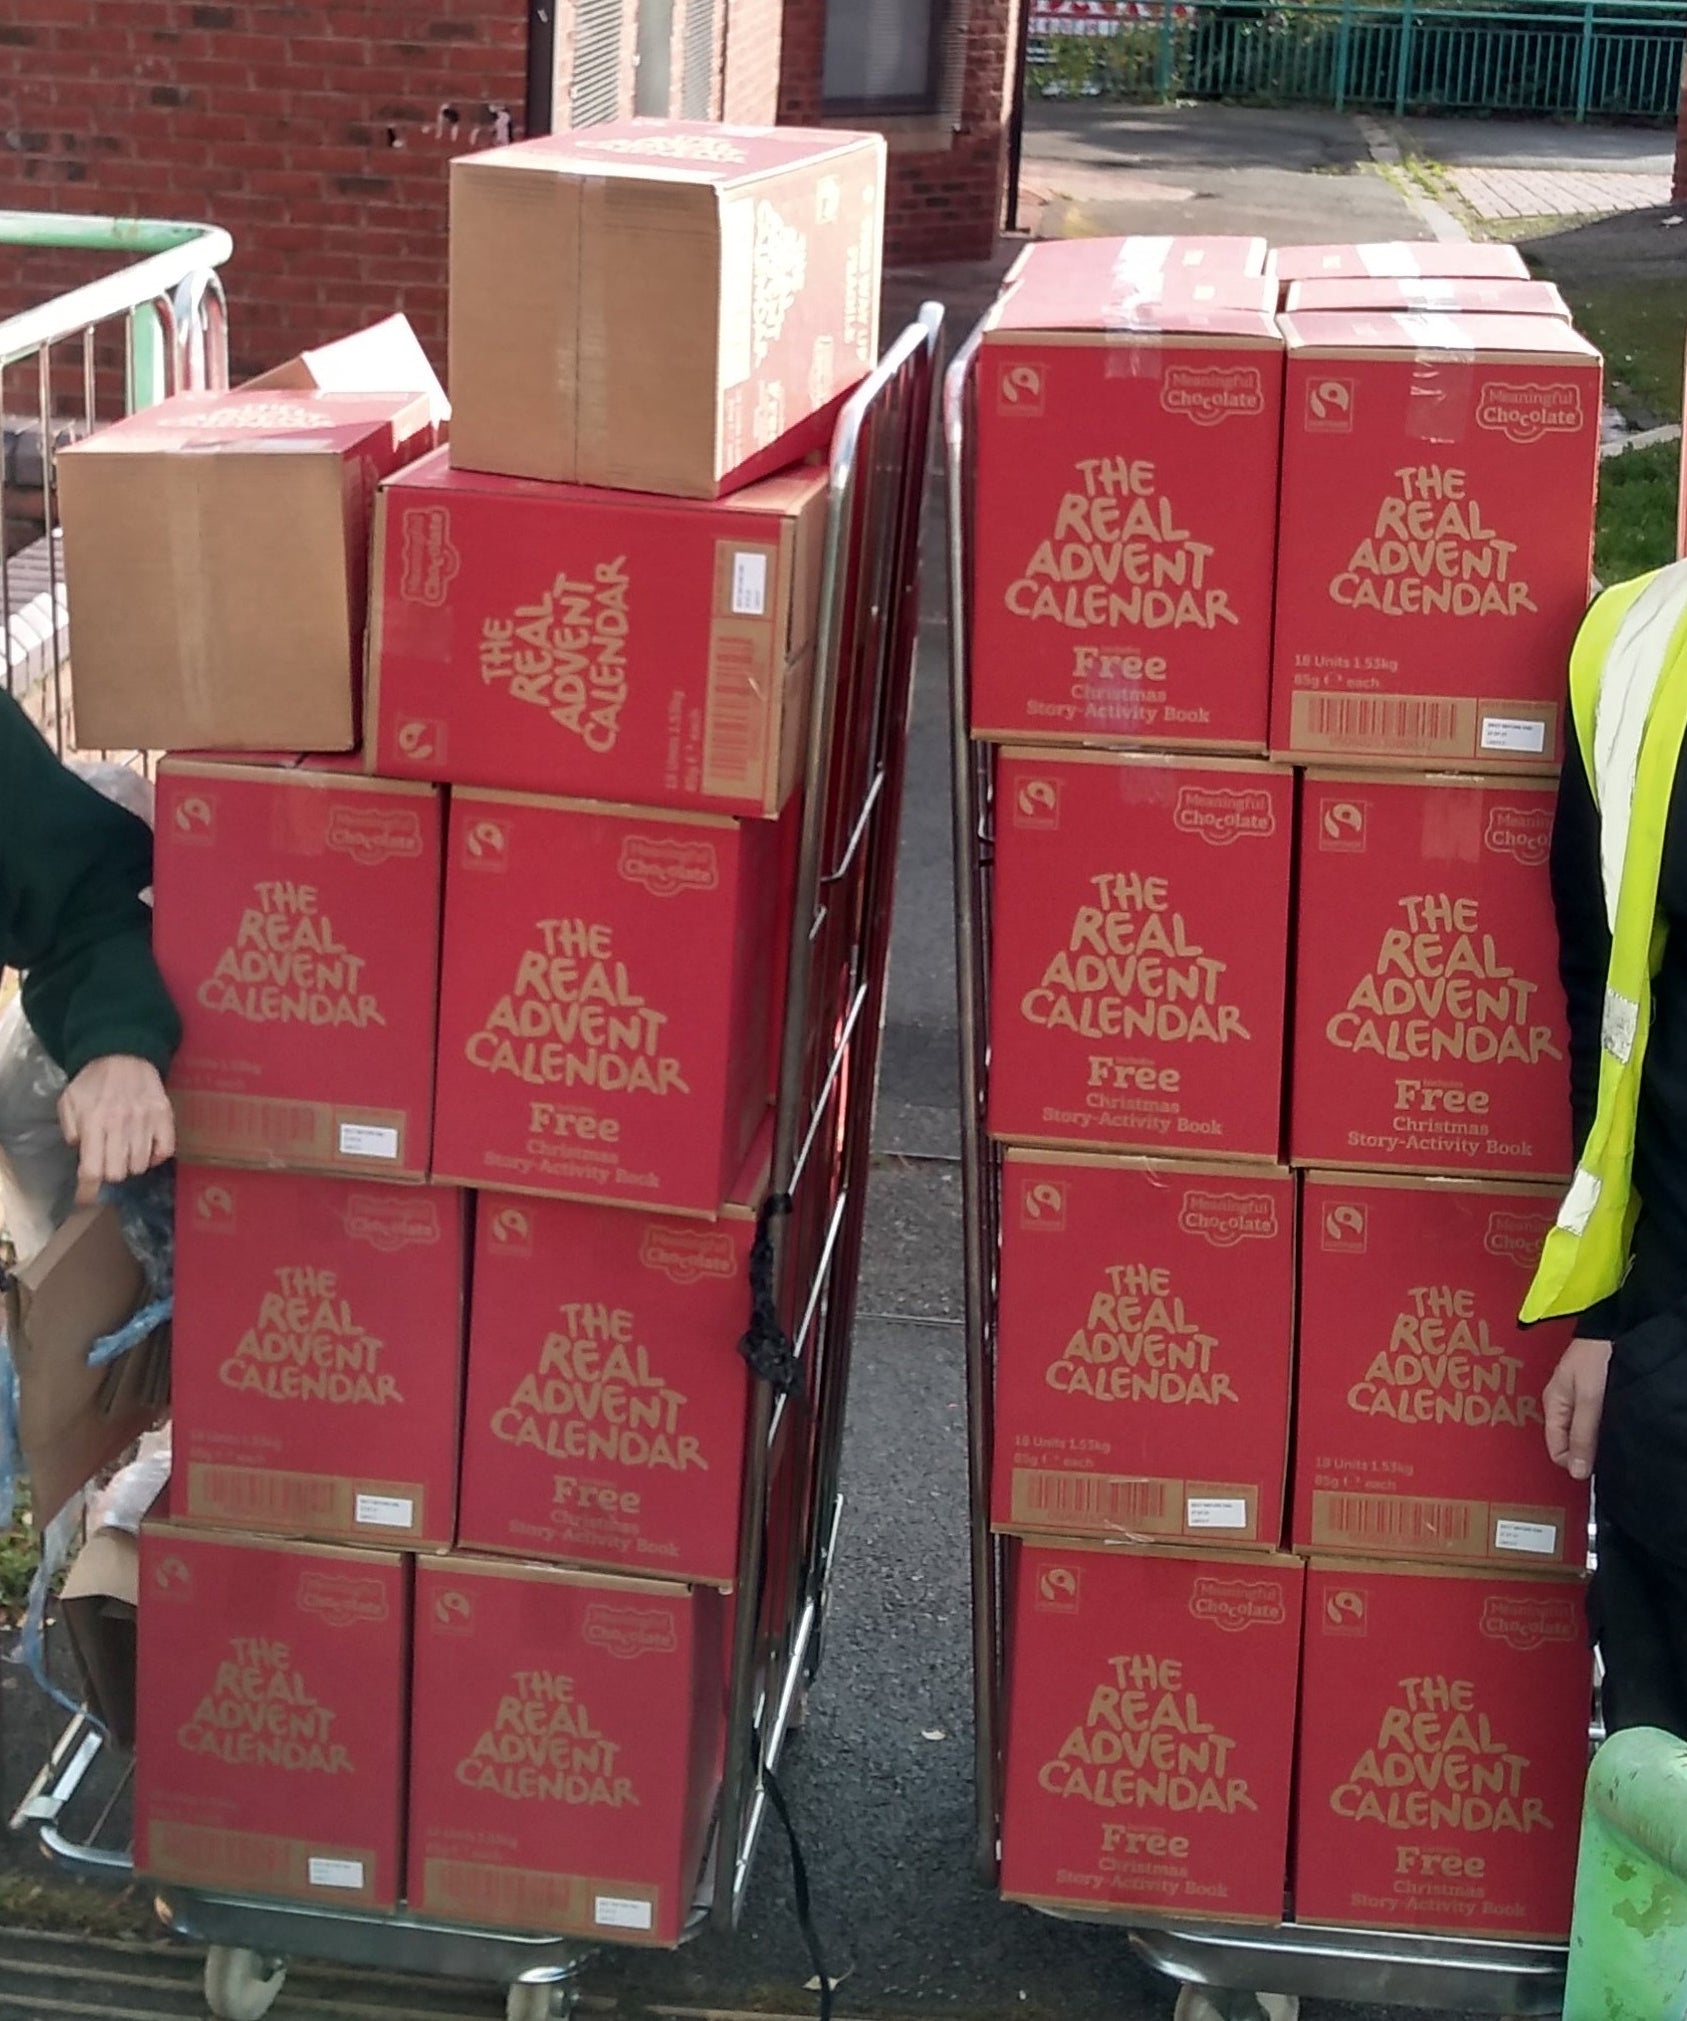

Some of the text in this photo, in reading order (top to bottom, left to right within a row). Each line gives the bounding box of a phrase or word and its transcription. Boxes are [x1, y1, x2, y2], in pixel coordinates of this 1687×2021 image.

[1168, 390, 1257, 410] Chocolate
[1483, 407, 1576, 425] Chocolate
[1075, 456, 1154, 497] THE
[1395, 465, 1466, 500] THE
[1054, 494, 1190, 543] REAL
[1375, 497, 1496, 541] REAL
[1025, 540, 1214, 589] ADVENT
[1349, 538, 1517, 582] ADVENT
[1004, 578, 1239, 629] CALENDAR
[1329, 572, 1537, 616] CALENDAR
[480, 616, 514, 685] THE
[509, 591, 554, 707] REAL
[550, 572, 595, 734] ADVENT
[583, 555, 630, 753] CALENDAR
[1072, 646, 1166, 681] Free
[1164, 706, 1210, 723] Book
[1181, 810, 1269, 829] Chocolate
[1492, 830, 1551, 850] Choco
[254, 880, 318, 914] THE
[1091, 872, 1168, 912] THE
[1399, 893, 1478, 933] THE
[237, 909, 346, 954] REAL
[536, 918, 613, 959] THE
[1070, 905, 1203, 956] REAL
[213, 947, 365, 995] ADVENT
[1377, 928, 1514, 979] REAL
[514, 950, 645, 1007] REAL
[1041, 952, 1226, 1004] ADVENT
[1347, 973, 1538, 1025] ADVENT
[197, 978, 386, 1028] CALENDAR
[485, 994, 668, 1056] ADVENT
[1021, 988, 1251, 1043] CALENDAR
[1326, 1012, 1563, 1064] CALENDAR
[465, 1031, 690, 1096] CALENDAR
[1087, 1055, 1180, 1092] Free
[1087, 1093, 1180, 1113] Christmas
[1394, 1079, 1489, 1115] Free
[529, 1102, 620, 1142] Free
[1178, 1117, 1223, 1134] Book
[1348, 1131, 1533, 1156] Story-Activity Book
[1393, 1116, 1489, 1135] Christmas
[1185, 1213, 1271, 1232] Chocolate
[274, 1265, 337, 1298] THE
[1105, 1263, 1171, 1296] THE
[1408, 1285, 1475, 1318] THE
[258, 1292, 366, 1336] REAL
[560, 1302, 634, 1343] THE
[1087, 1291, 1199, 1334] REAL
[1390, 1313, 1504, 1356] REAL
[235, 1328, 384, 1374] ADVENT
[539, 1332, 665, 1387] REAL
[1062, 1329, 1219, 1373] ADVENT
[1364, 1351, 1524, 1394] ADVENT
[219, 1357, 405, 1406] CALENDAR
[1046, 1360, 1239, 1405] CALENDAR
[510, 1373, 687, 1435] ADVENT
[1347, 1382, 1545, 1427] CALENDAR
[490, 1407, 709, 1471] CALENDAR
[552, 1474, 641, 1514] Free
[1196, 1600, 1279, 1618] Chocolate
[229, 1637, 290, 1670] THE
[1108, 1654, 1183, 1691] THE
[215, 1660, 317, 1707] REAL
[512, 1670, 575, 1702] THE
[1398, 1675, 1475, 1712] THE
[193, 1696, 336, 1743] ADVENT
[496, 1696, 603, 1739] REAL
[1086, 1684, 1214, 1734] REAL
[1378, 1705, 1508, 1754] REAL
[177, 1723, 355, 1775] CALENDAR
[472, 1731, 619, 1777] ADVENT
[1058, 1726, 1236, 1779] ADVENT
[455, 1756, 640, 1808] CALENDAR
[1038, 1760, 1258, 1814] CALENDAR
[1350, 1748, 1530, 1797] ADVENT
[1330, 1784, 1554, 1833] CALENDAR
[1102, 1823, 1189, 1858] Free
[1396, 1846, 1485, 1878] Free
[1185, 1881, 1228, 1898] Book
